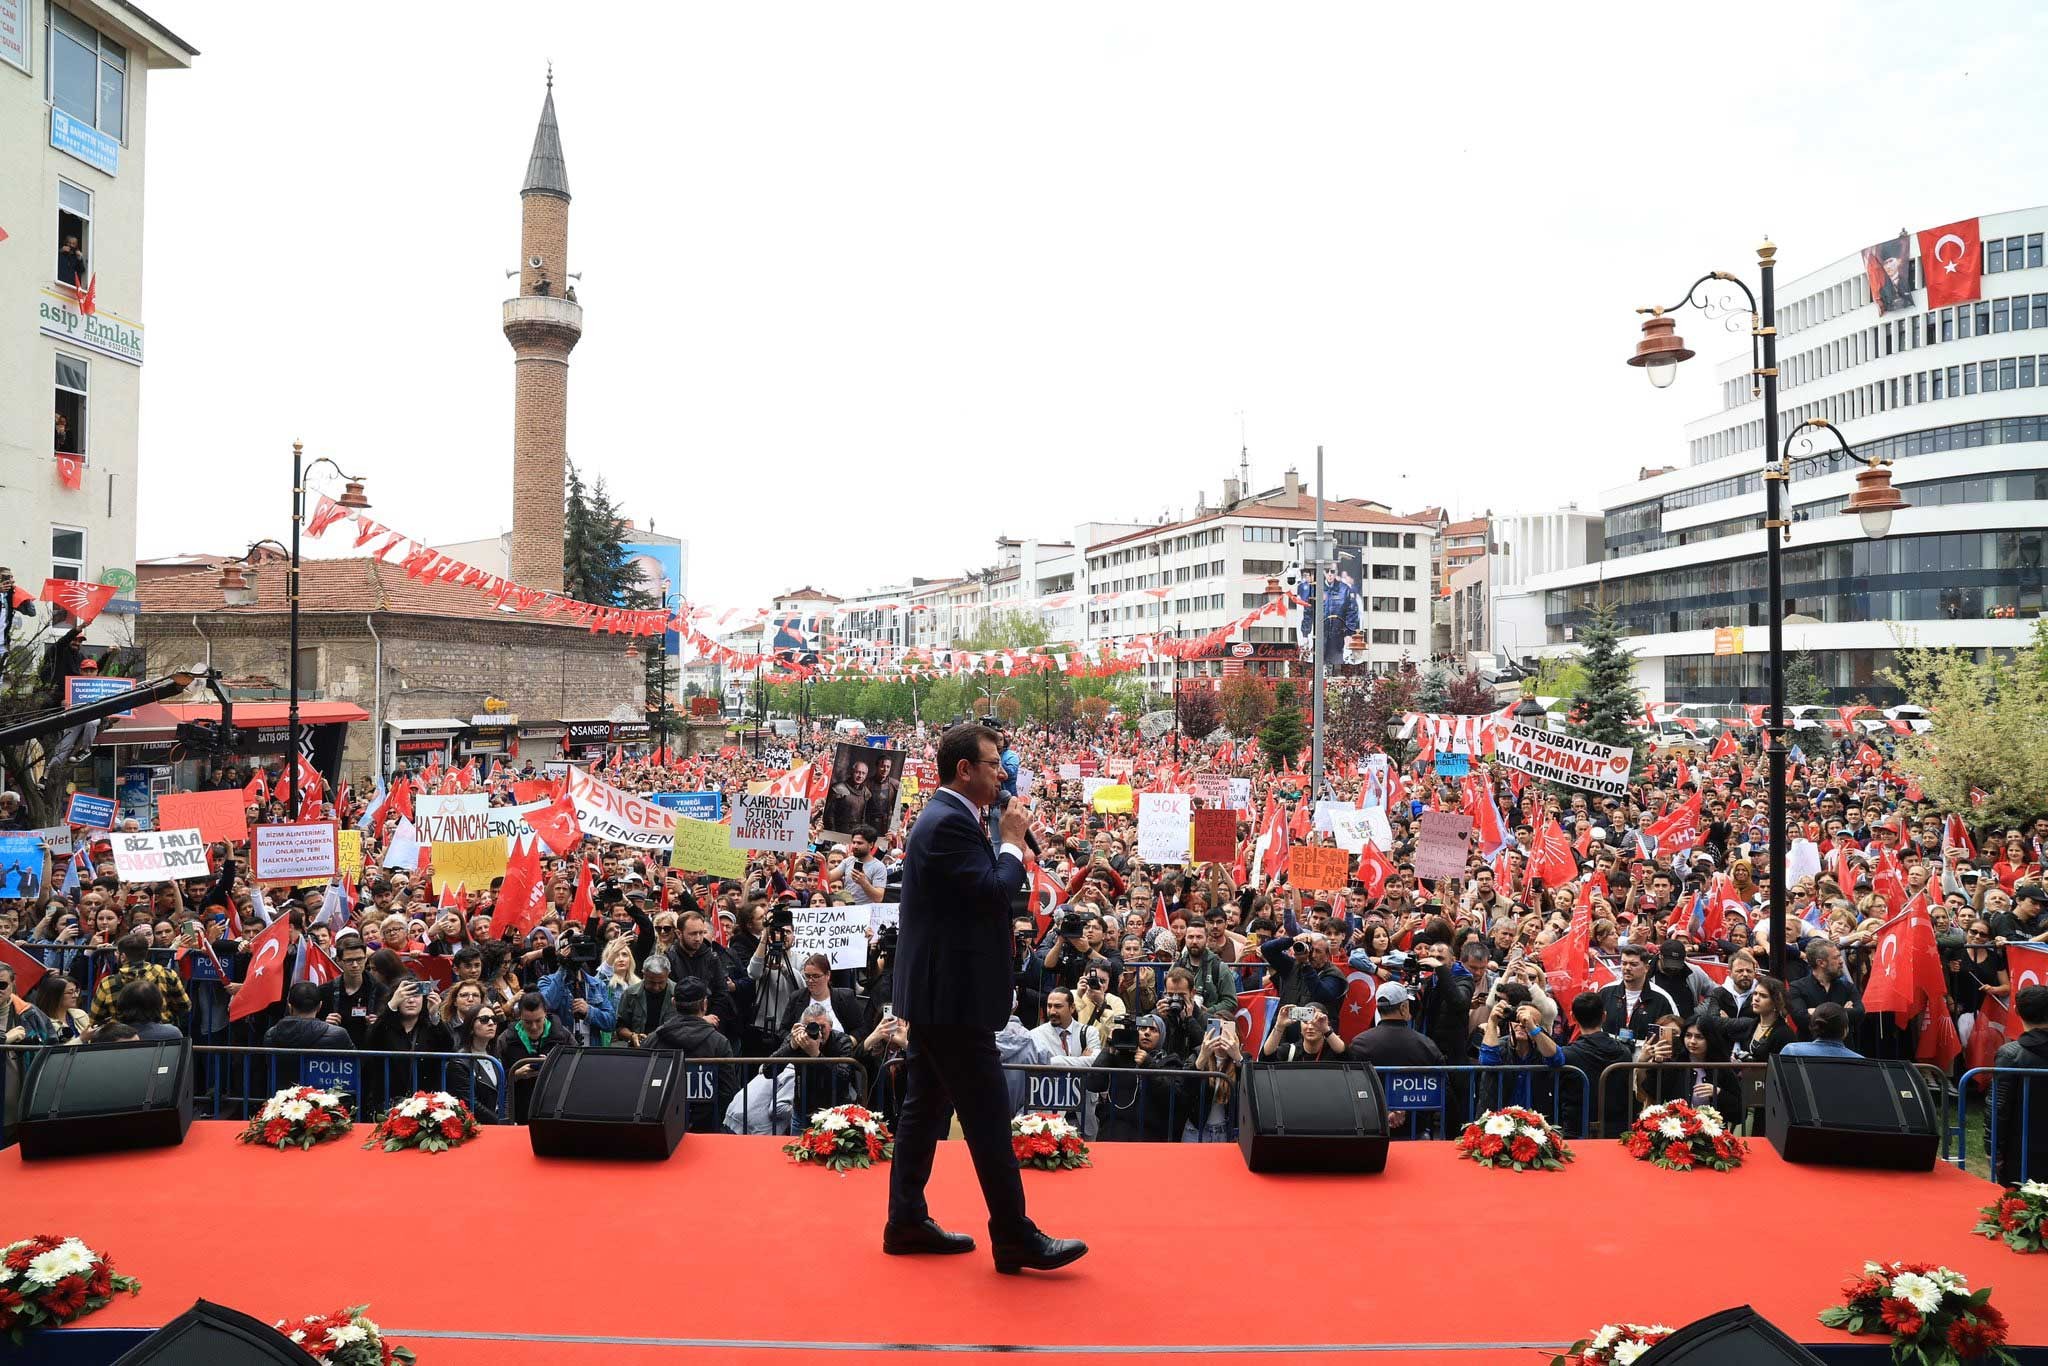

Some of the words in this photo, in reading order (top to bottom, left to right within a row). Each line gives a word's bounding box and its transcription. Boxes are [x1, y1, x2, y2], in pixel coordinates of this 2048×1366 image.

[85, 314, 140, 350] Emlak
[258, 733, 275, 743] SATIŞ
[276, 732, 290, 741] OFİS
[1512, 724, 1612, 759] ASTSUBAYLAR
[740, 794, 809, 810] KAHROLSUN
[1152, 799, 1180, 815] YOK
[415, 813, 489, 842] KAZANACAK
[589, 815, 674, 845] MENGEN
[294, 838, 332, 846] ÇALIŞIRKEN
[295, 855, 330, 863] ÇALARKEN
[1321, 877, 1347, 889] MAN
[829, 925, 868, 936] SORACAK
[1028, 1072, 1081, 1107] POLİS
[1754, 1080, 1765, 1091] P
